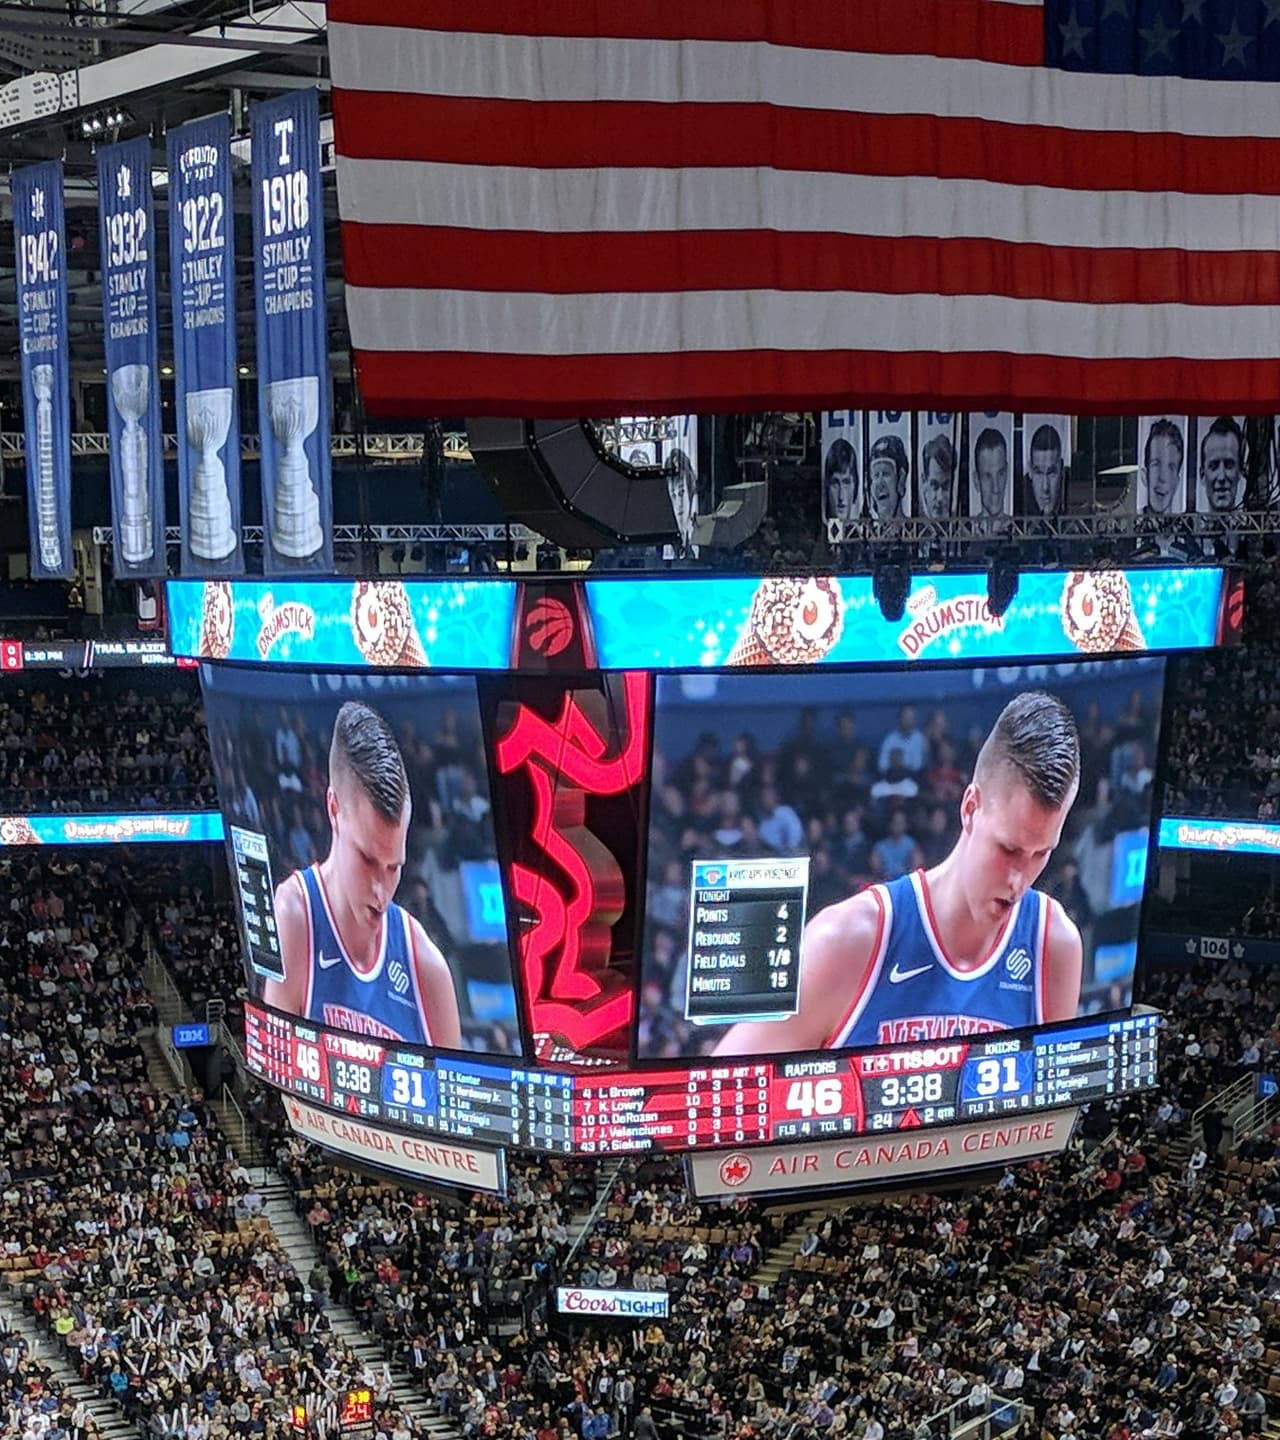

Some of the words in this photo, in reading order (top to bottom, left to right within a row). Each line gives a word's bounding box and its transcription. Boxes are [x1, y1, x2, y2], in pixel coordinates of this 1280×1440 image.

[263, 169, 309, 237] 1918
[105, 206, 148, 268] 1932
[20, 229, 59, 285] 1942
[263, 235, 311, 268] STANLEY
[108, 268, 147, 296] STANLEY
[276, 266, 298, 291] CUP
[22, 288, 57, 312] STANLEY
[119, 295, 137, 318] CUP
[264, 289, 313, 315] CHAMPIONS
[32, 314, 51, 333] CUP
[259, 606, 312, 655] DRUMSTICK
[698, 890, 731, 903] TONIGHT
[777, 904, 788, 920] 4
[776, 927, 787, 943] 2
[1202, 938, 1228, 957] 106
[770, 971, 788, 988] 15
[179, 1029, 204, 1042] IBM
[891, 1045, 962, 1070] TISSOT
[984, 1040, 1020, 1056] KNICKS
[296, 1043, 321, 1082] 46
[784, 1060, 837, 1078] RAPTORS
[335, 1060, 371, 1094] 3:38
[392, 1068, 426, 1108] 31
[582, 1088, 592, 1098] 4
[610, 1086, 645, 1098] Brown
[758, 1077, 767, 1087] 0
[976, 1056, 1020, 1096] 31
[786, 1078, 843, 1117] 46
[881, 1072, 943, 1107] 3:38
[360, 1099, 367, 1114] 2
[611, 1100, 644, 1113] Lowry
[685, 1095, 700, 1106] 10
[581, 1115, 595, 1126] 10
[778, 1125, 796, 1137] FLS
[800, 1122, 811, 1135] 4
[843, 1118, 852, 1130] 5
[872, 1113, 893, 1130] 24
[924, 1108, 935, 1123] 2
[306, 1110, 329, 1135] AIR
[331, 1118, 399, 1156] CANADA
[400, 1139, 481, 1174] CENTRE
[581, 1128, 595, 1138] 17
[768, 1153, 819, 1177] AIR
[835, 1137, 950, 1170] CANADA
[962, 1119, 1057, 1153] CENTRE
[565, 1290, 616, 1312] Coors
[619, 1299, 667, 1315] LIGHT
[346, 1403, 370, 1420] 24
